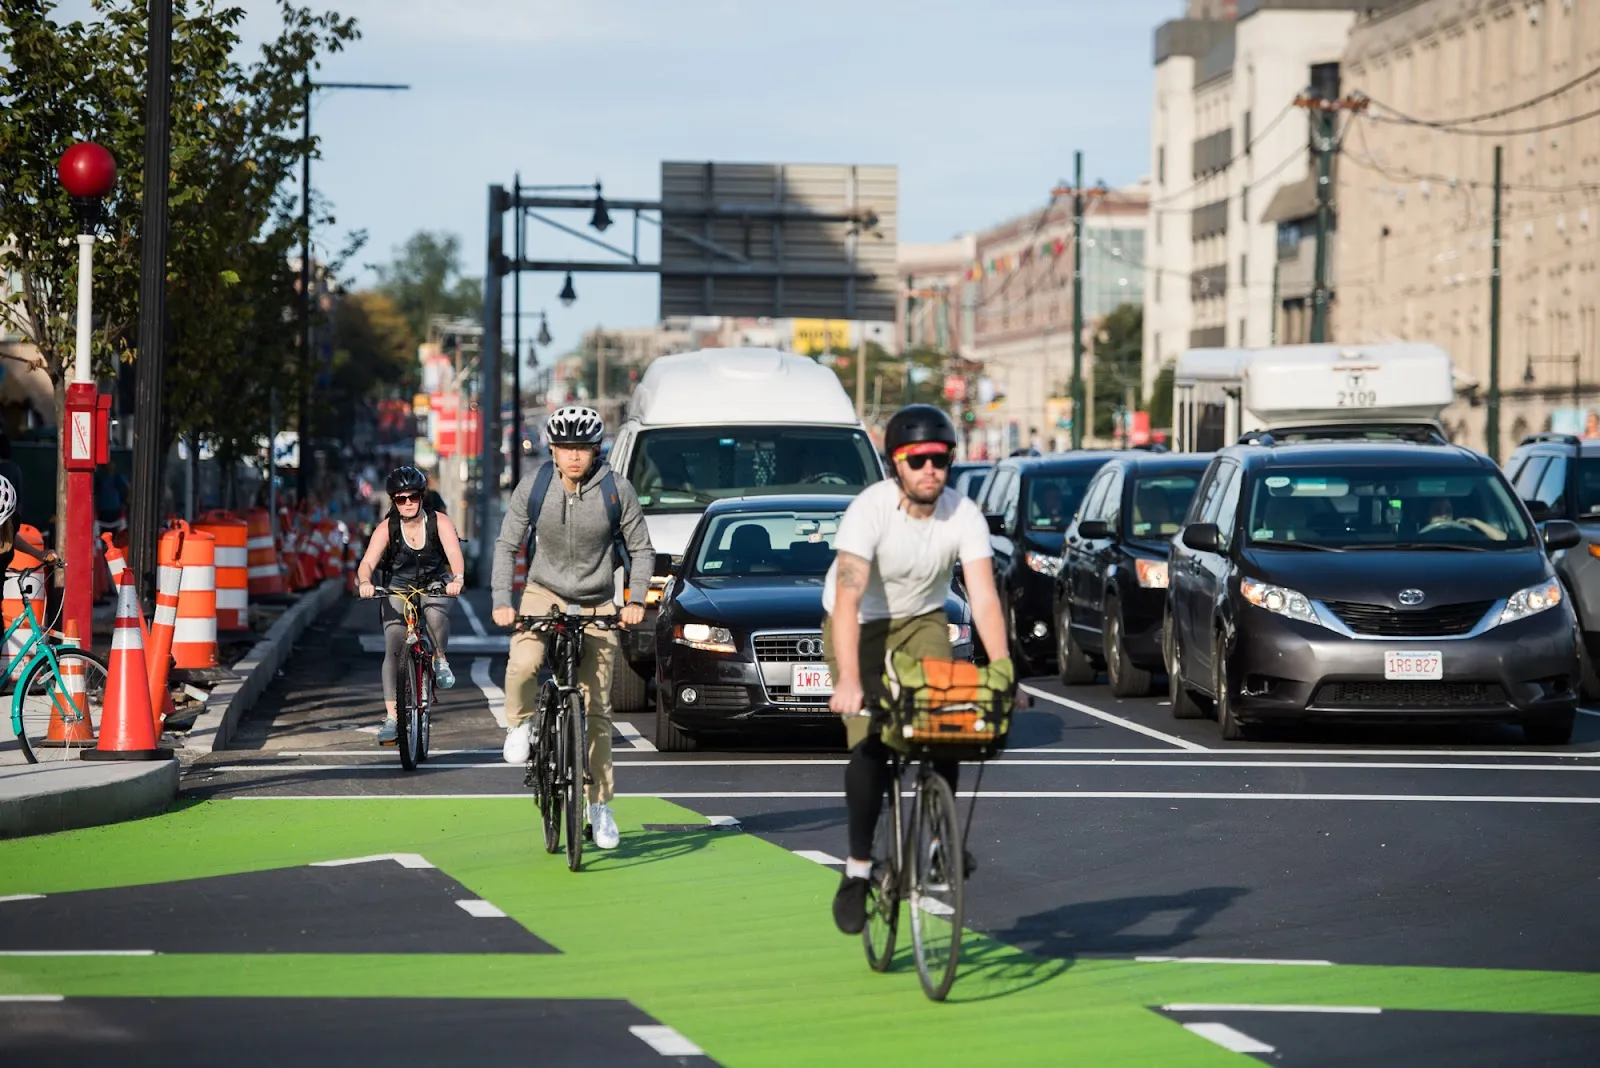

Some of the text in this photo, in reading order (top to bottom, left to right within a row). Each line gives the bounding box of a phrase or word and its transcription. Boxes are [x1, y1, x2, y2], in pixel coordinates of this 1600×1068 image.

[1336, 391, 1377, 407] 2109
[1389, 658, 1438, 673] 1RG 827
[797, 672, 821, 687] 1WR
